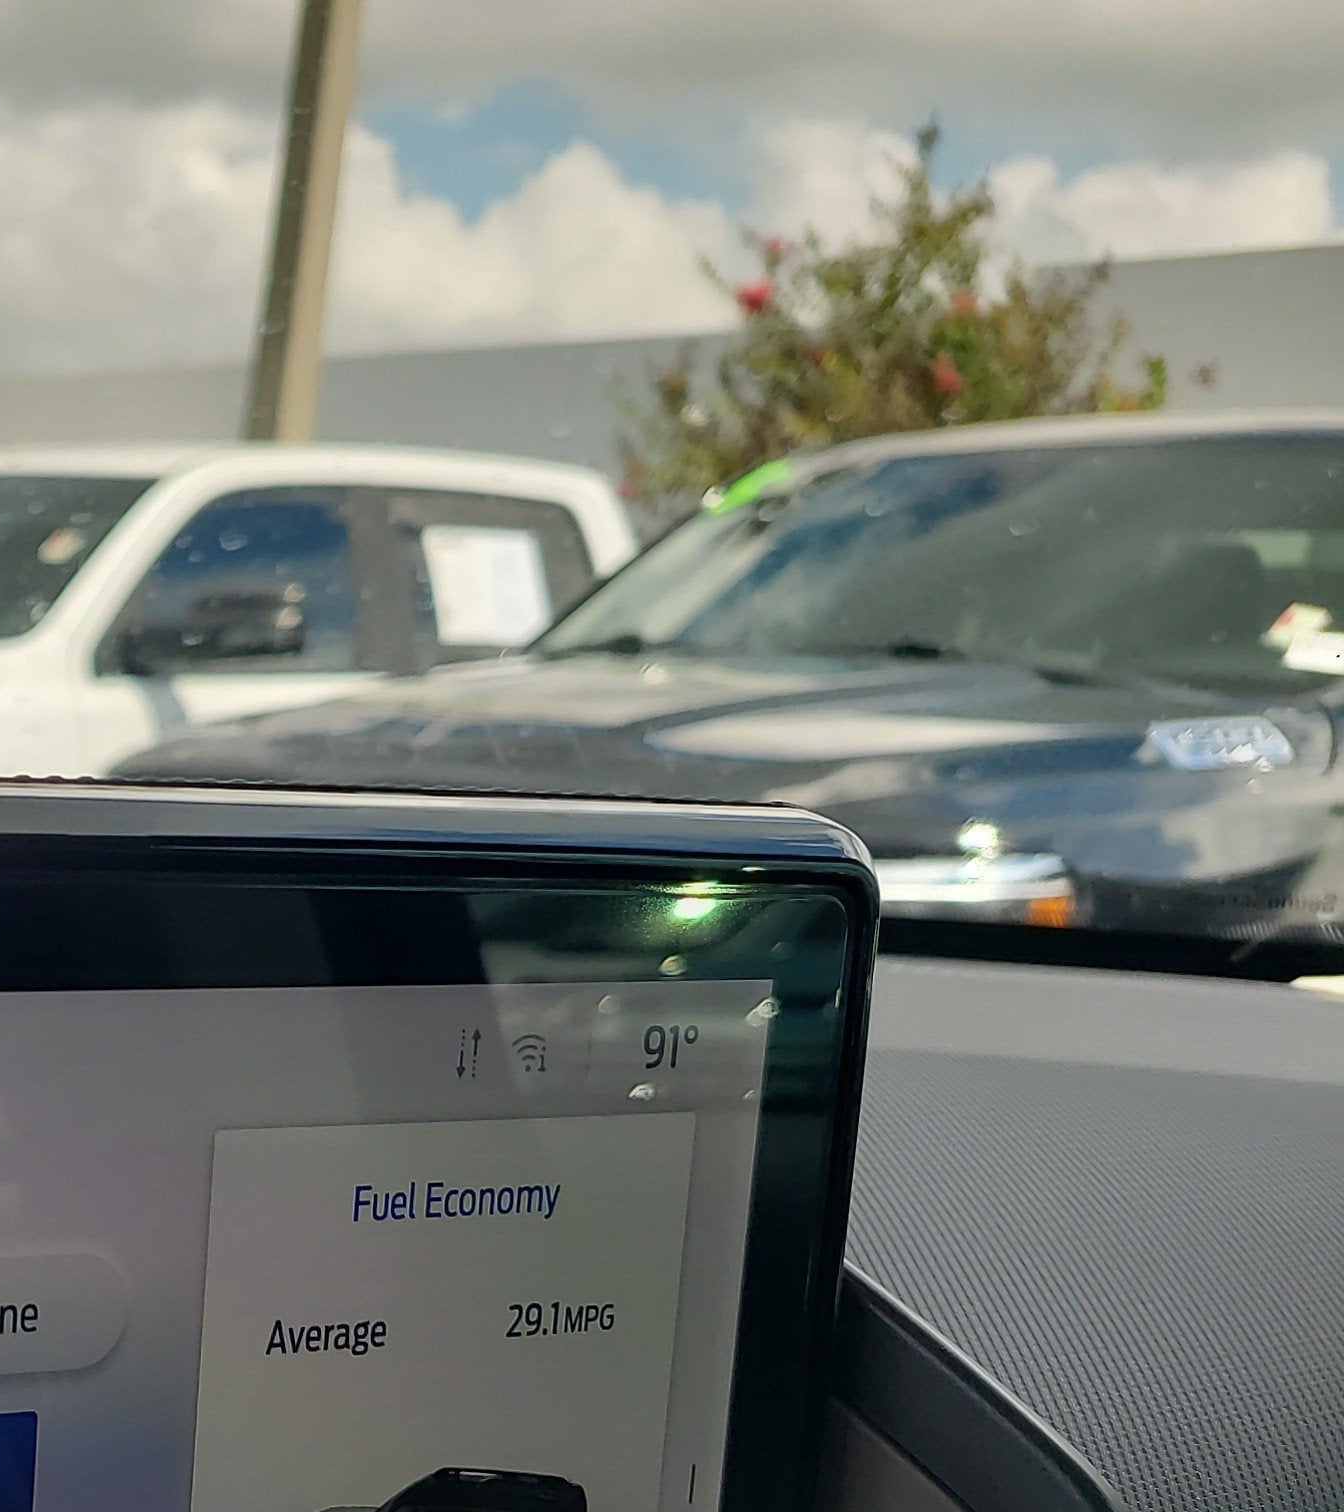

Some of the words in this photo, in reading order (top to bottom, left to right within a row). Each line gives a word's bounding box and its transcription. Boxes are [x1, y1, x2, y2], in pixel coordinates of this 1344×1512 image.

[354, 1182, 415, 1221] Fuel
[426, 1182, 560, 1219] Economy
[266, 1320, 386, 1355] Average
